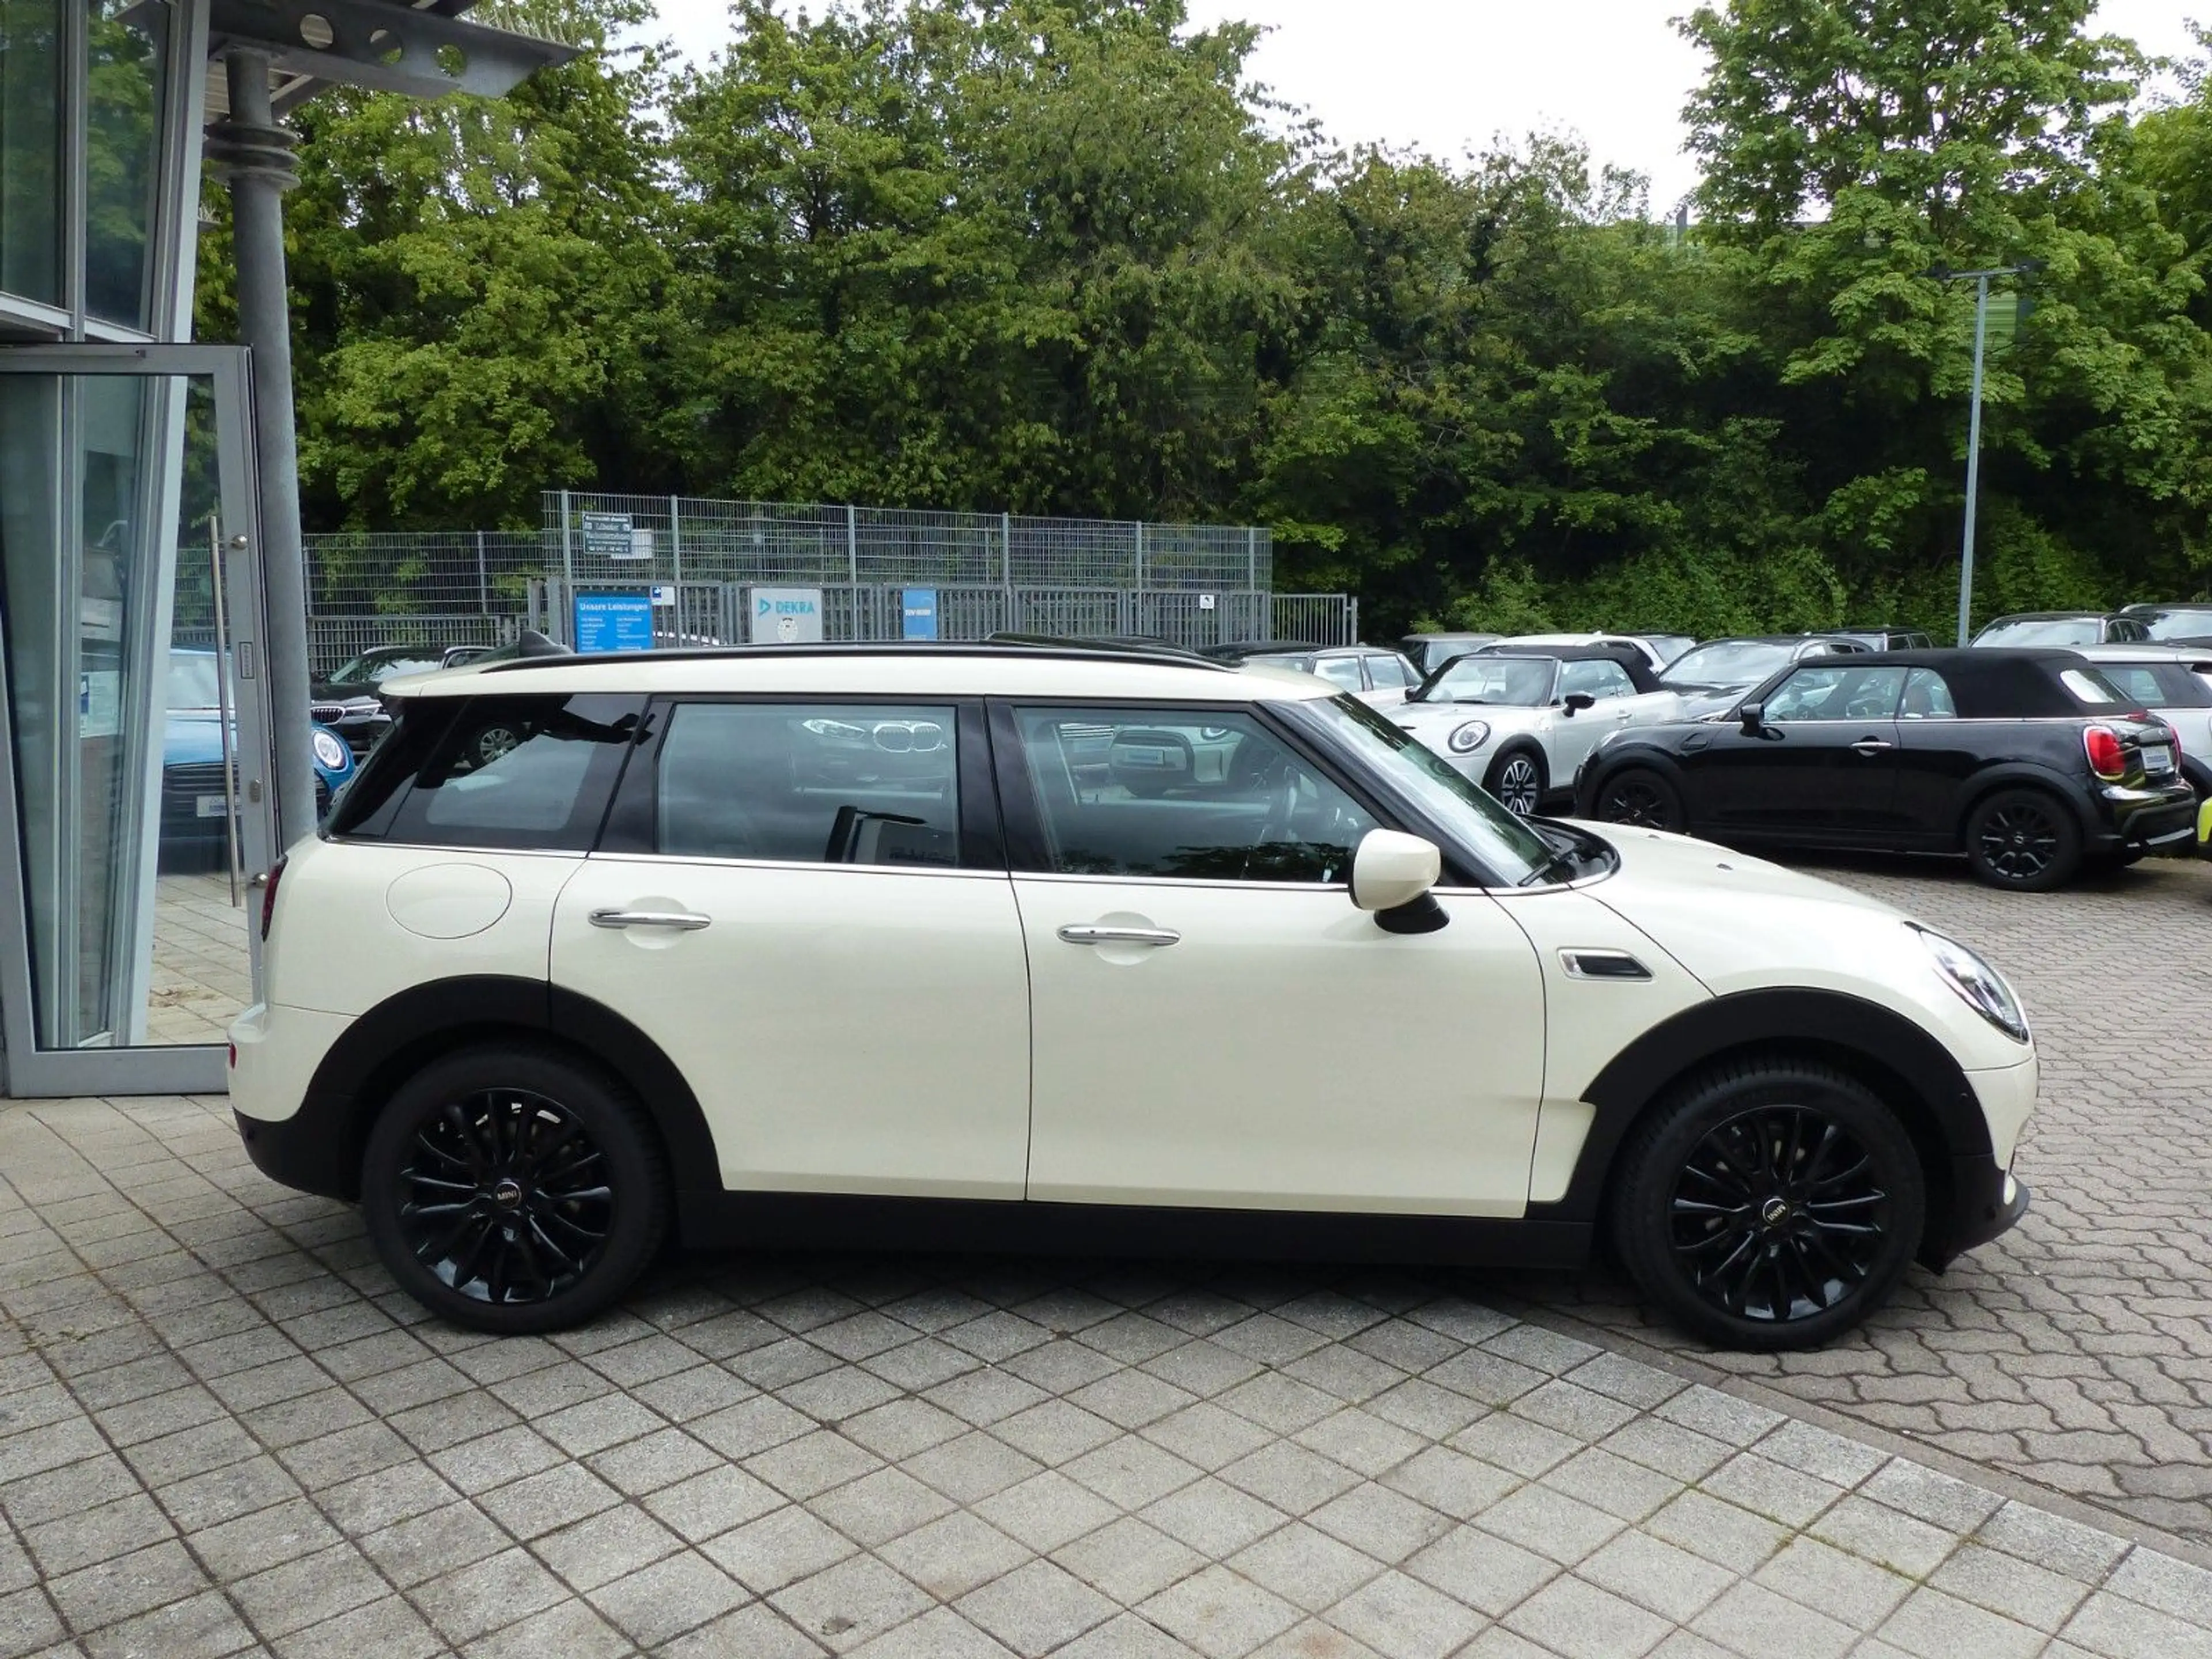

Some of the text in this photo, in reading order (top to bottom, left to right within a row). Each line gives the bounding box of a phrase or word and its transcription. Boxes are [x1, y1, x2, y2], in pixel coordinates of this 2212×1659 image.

[579, 603, 648, 612] Unsere Leistungen
[775, 601, 815, 614] DEKRA
[497, 1191, 517, 1201] MINI
[1767, 1204, 1786, 1221] MINI
